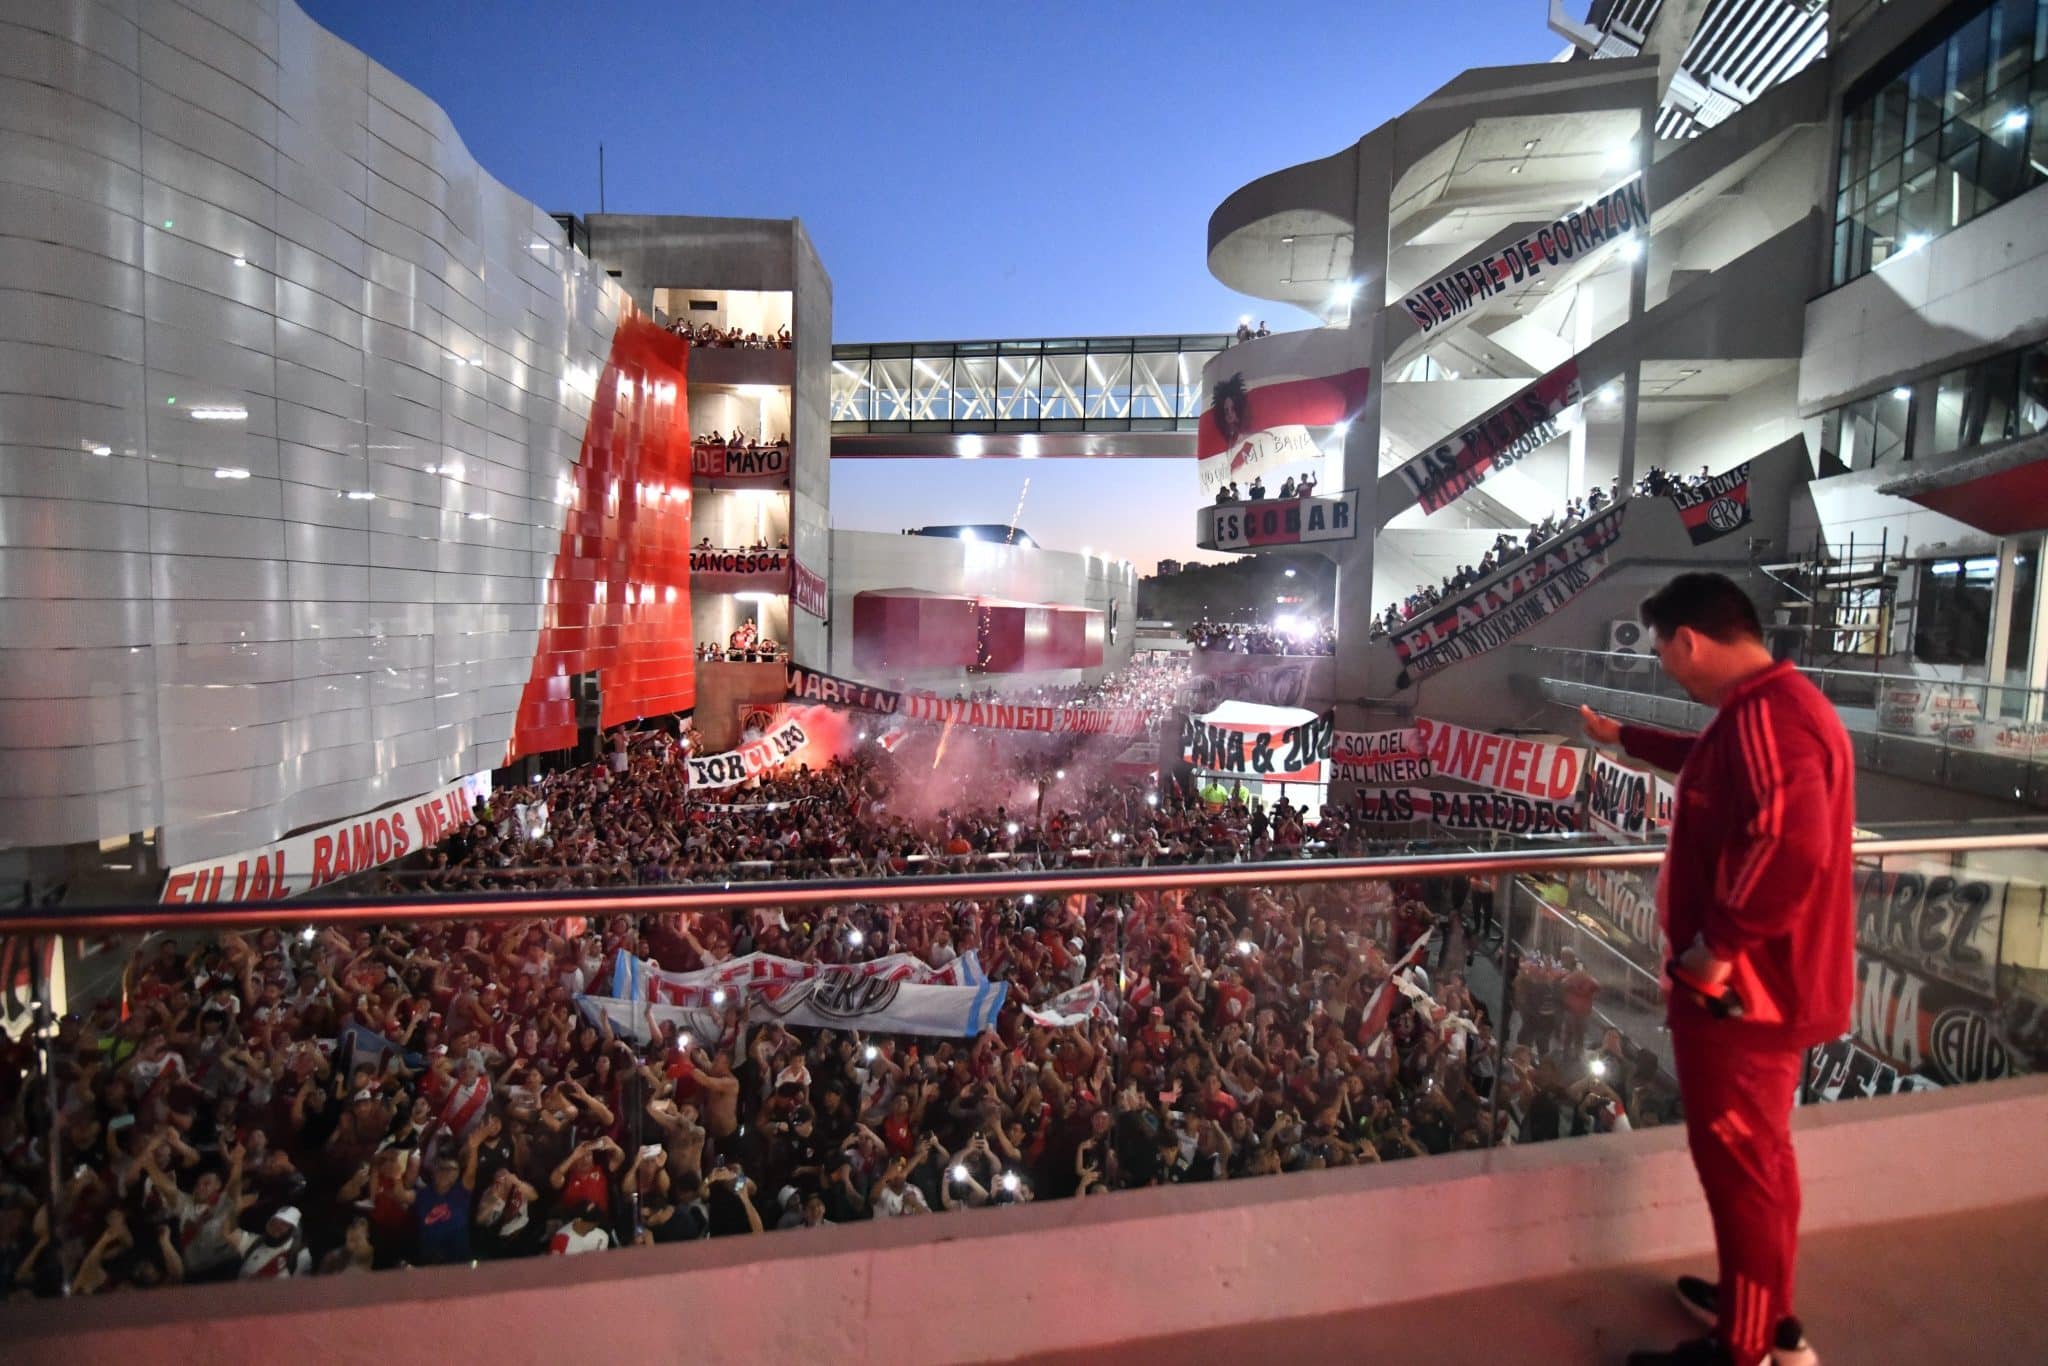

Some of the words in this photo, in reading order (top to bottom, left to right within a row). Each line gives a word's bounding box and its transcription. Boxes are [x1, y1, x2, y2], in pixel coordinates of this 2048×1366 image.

[1406, 257, 1506, 332] SIEMPRE
[1507, 239, 1541, 284] DE
[1537, 179, 1648, 266] CORAZON
[697, 450, 722, 473] DE
[726, 450, 782, 474] MAYO
[1493, 414, 1558, 472] ESCOBAR
[1404, 444, 1458, 494] LAS
[1674, 487, 1705, 510] LAS
[1706, 464, 1750, 499] TUNAS
[1217, 501, 1349, 542] ESCOBAR
[1401, 620, 1450, 658] EL
[1455, 537, 1590, 633] ALVEAR
[1559, 562, 1590, 594] VOS
[1059, 708, 1112, 734] PARQUE
[1252, 731, 1275, 774] &
[1345, 735, 1374, 757] SOY
[1379, 731, 1407, 755] DEL
[1416, 717, 1578, 800] BANFIELD
[1330, 757, 1432, 783] GALLINERO
[1357, 789, 1414, 822] LAS
[1430, 791, 1576, 834] PAREDES
[310, 812, 411, 889] RAMOS
[415, 786, 473, 848] MEJIA
[1857, 871, 1991, 964] AREZ
